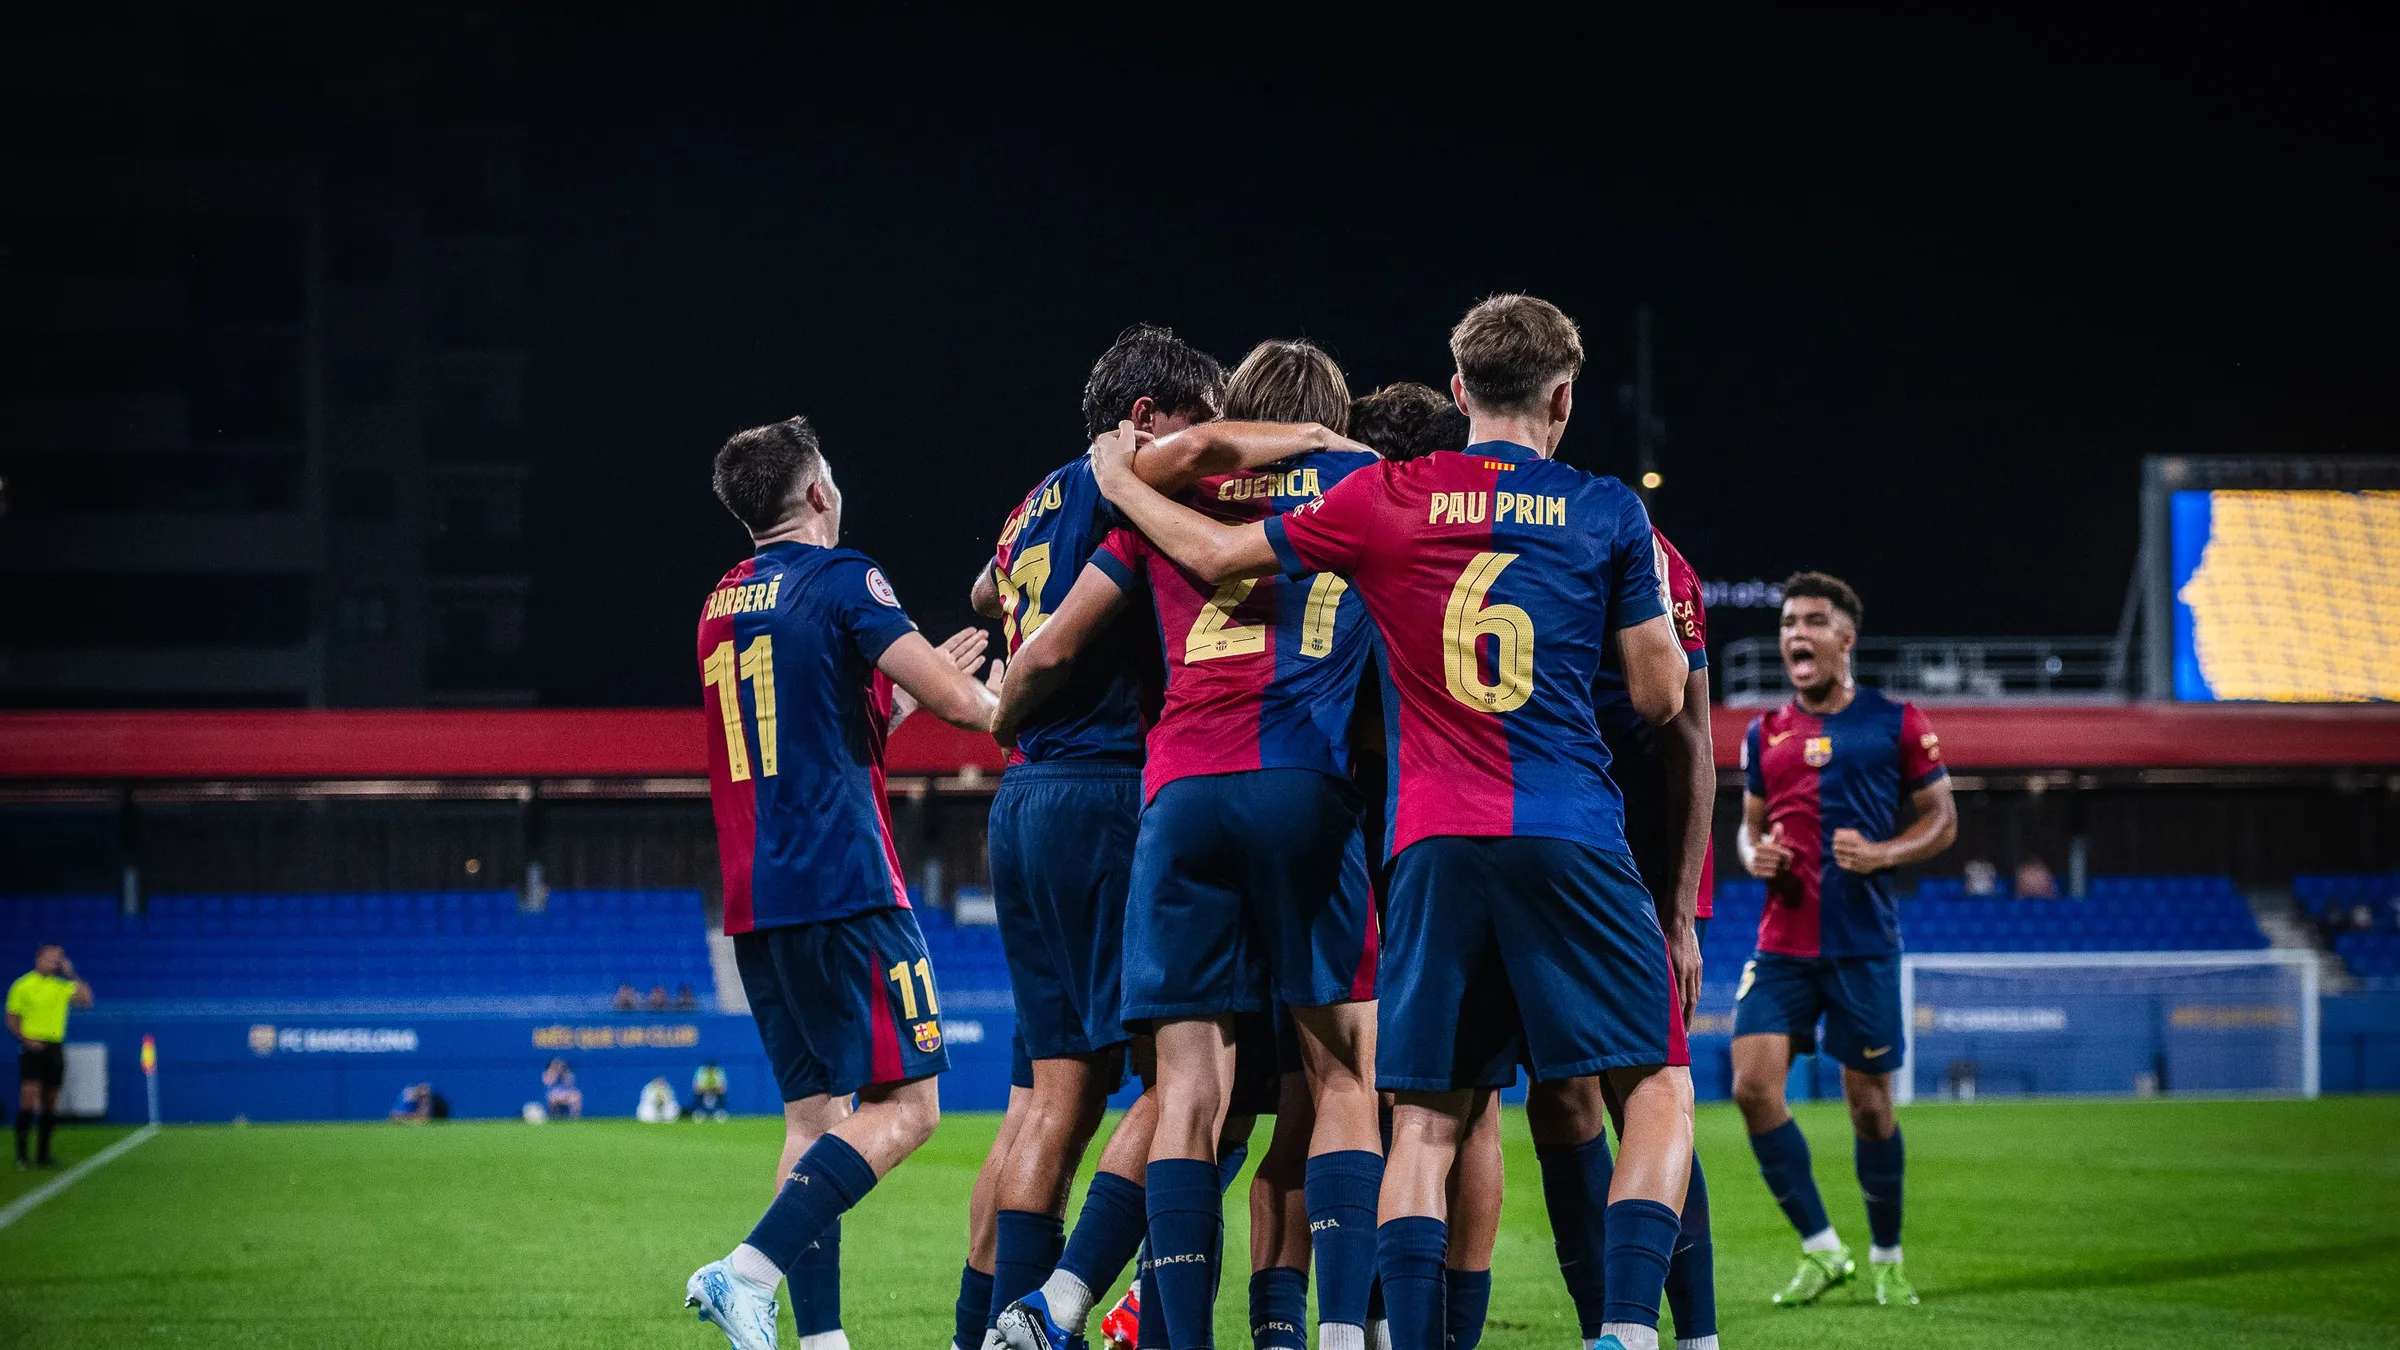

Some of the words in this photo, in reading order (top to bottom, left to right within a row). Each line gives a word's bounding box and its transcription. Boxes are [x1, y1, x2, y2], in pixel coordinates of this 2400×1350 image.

[1217, 468, 1321, 501] CUENCA
[1429, 491, 1487, 525] PAU
[1495, 491, 1566, 527] PRIM
[1443, 552, 1534, 713] 6
[703, 634, 777, 781] 11
[889, 957, 938, 1020] 11
